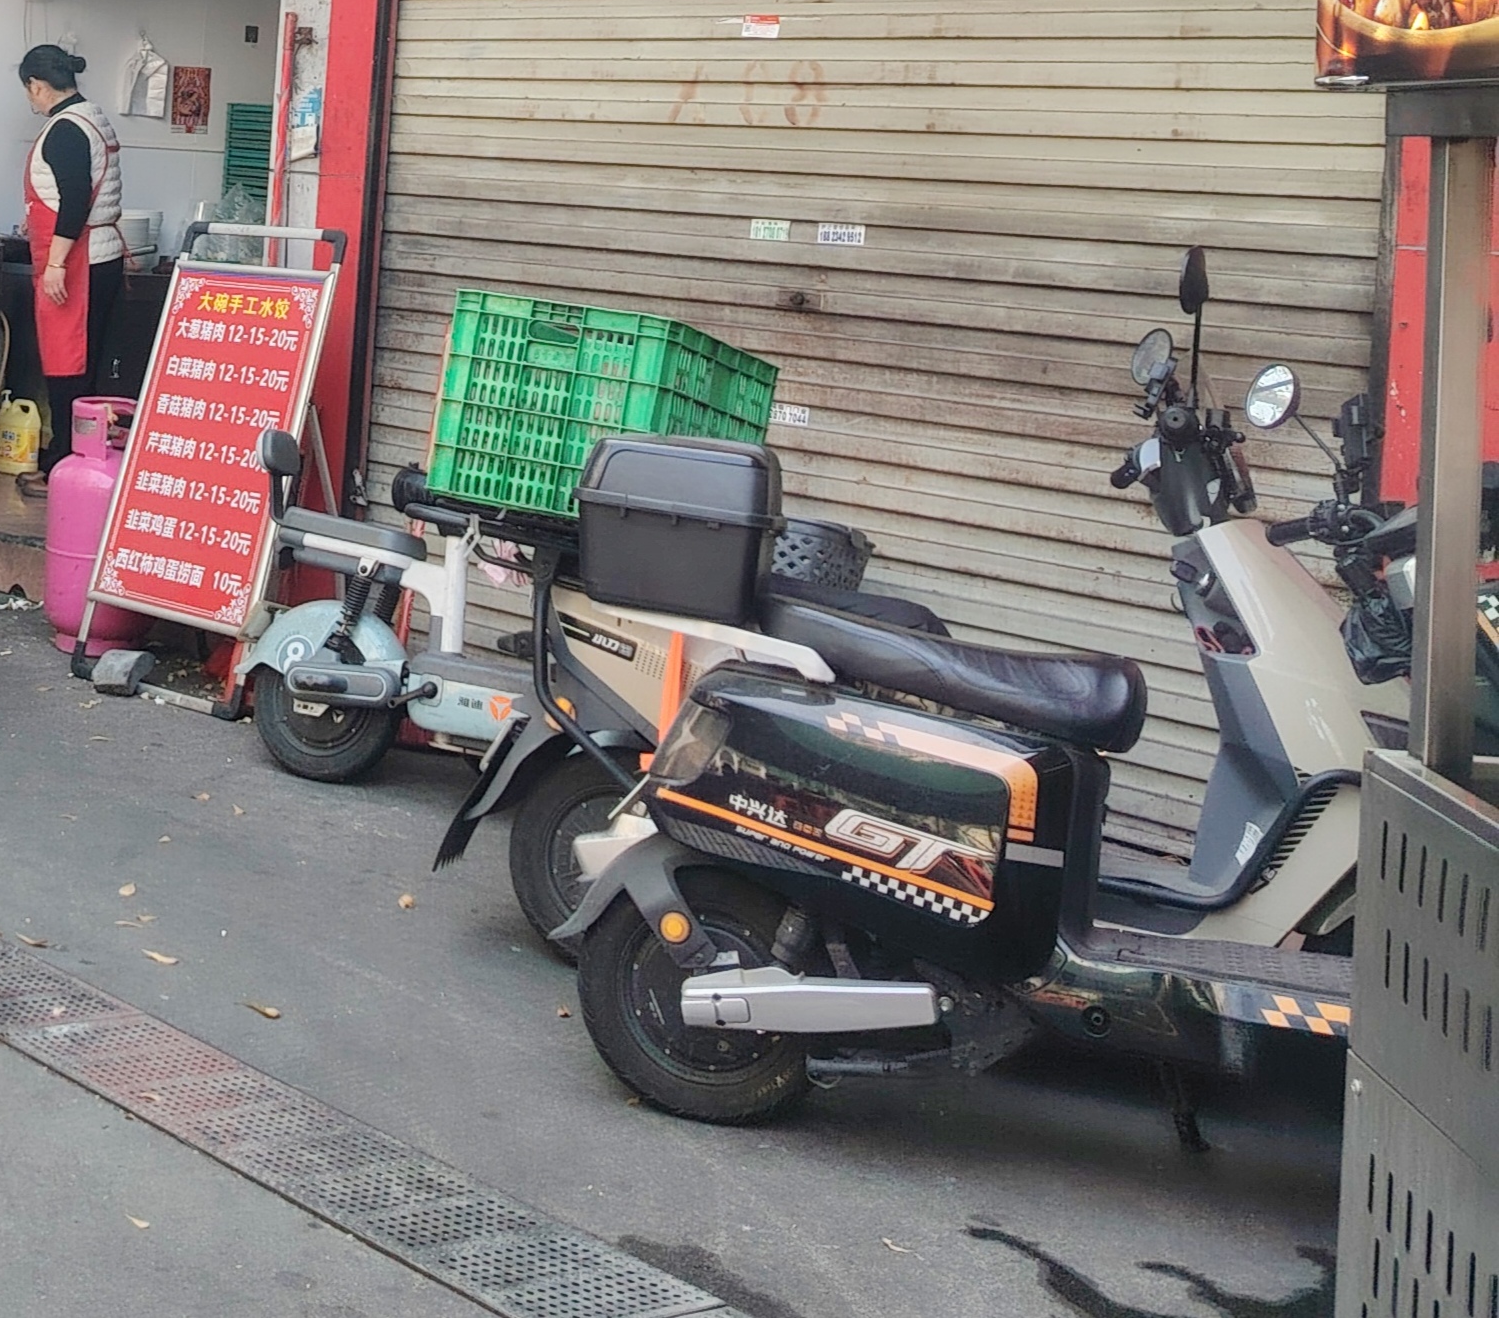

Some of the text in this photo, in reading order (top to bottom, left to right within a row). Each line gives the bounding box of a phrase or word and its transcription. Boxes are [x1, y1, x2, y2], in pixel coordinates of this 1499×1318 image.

[197, 292, 291, 321] 大碗手工水饺
[175, 317, 299, 352] 大葱猪肉 12-15-20元
[165, 355, 290, 392] 白菜猪肉 12-15-20元
[156, 393, 280, 430] 香菇猪肉 12-15-20元
[145, 431, 268, 474] 芹菜猪肉 12-15-20
[135, 470, 262, 514] 韭菜猪肉 12-15-20元
[125, 508, 252, 556] 韭菜鸡蛋 12-15-20元
[114, 548, 242, 597] 西红柿鸡蛋捞面 10元
[729, 794, 789, 829] 中兴达
[824, 808, 999, 874] GT
